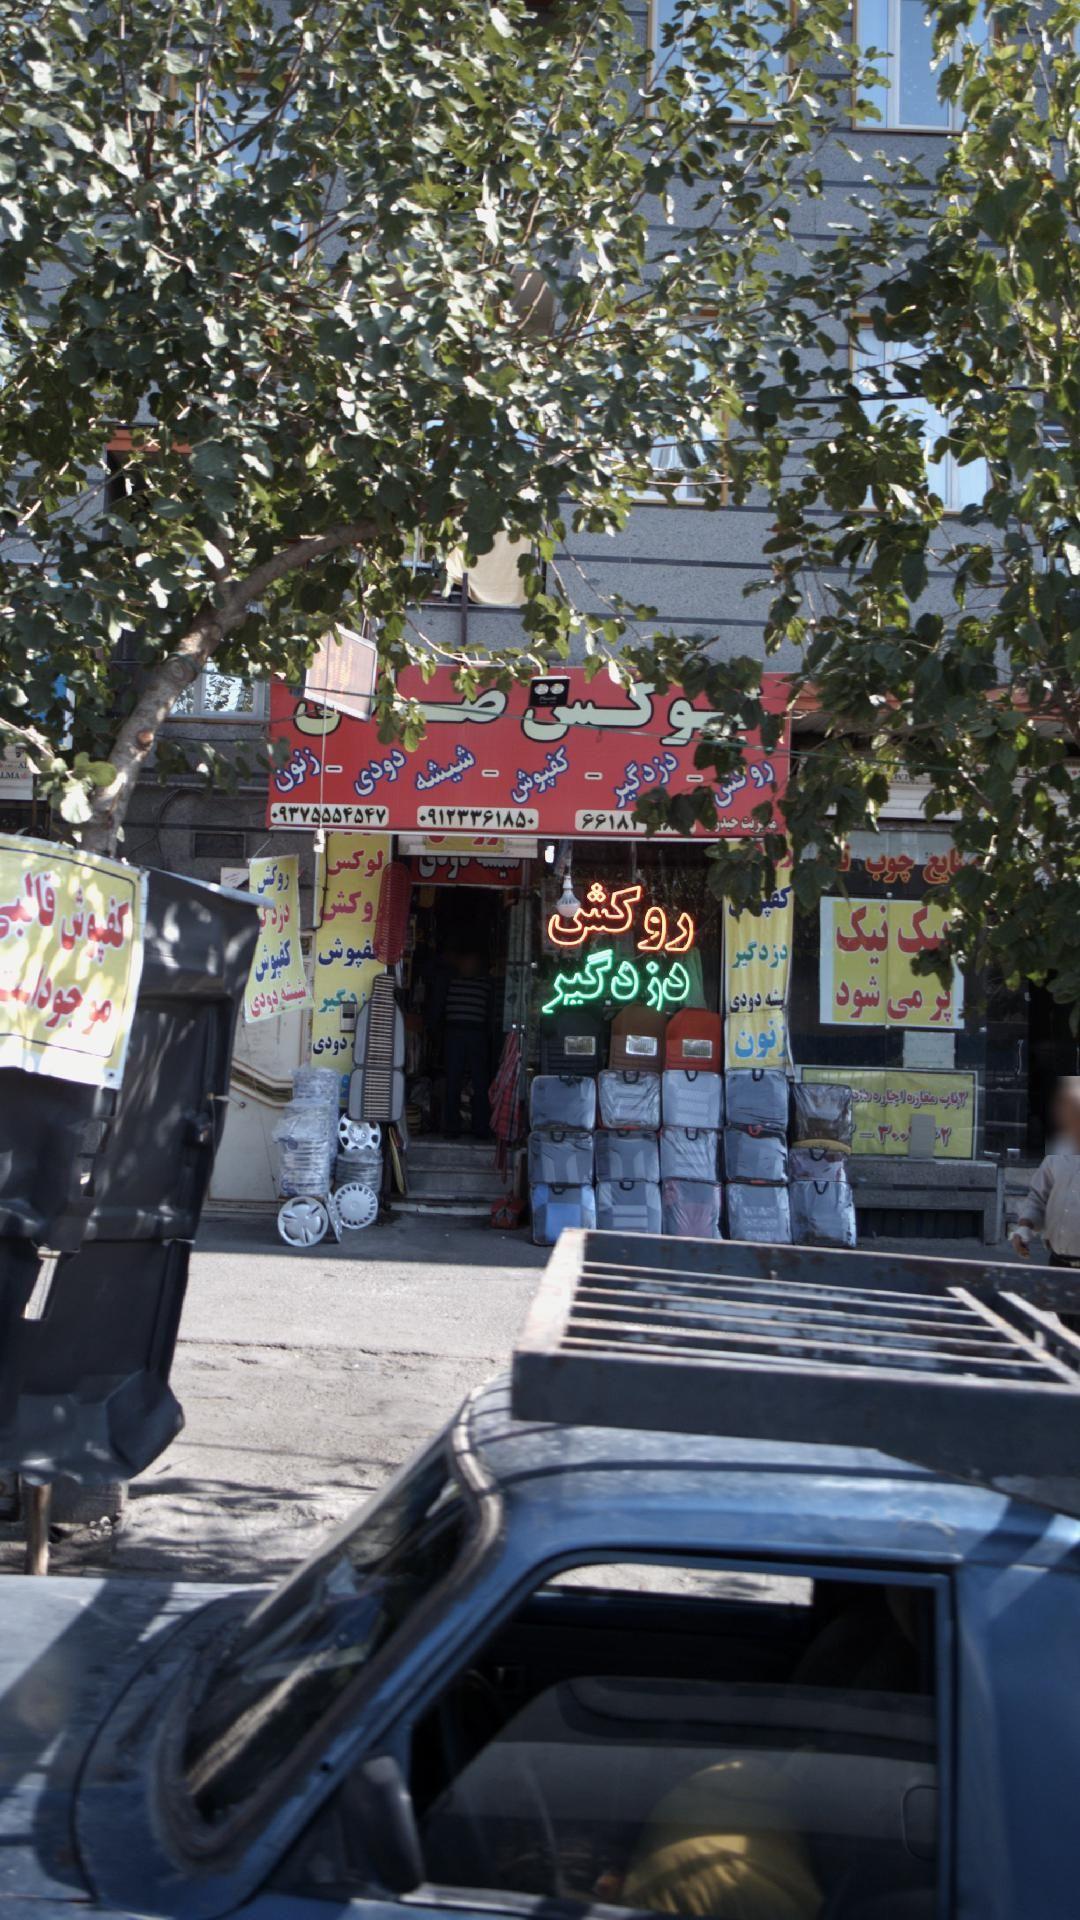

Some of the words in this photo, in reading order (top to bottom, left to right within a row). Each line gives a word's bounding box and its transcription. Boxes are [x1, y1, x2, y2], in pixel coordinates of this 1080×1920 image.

[521, 680, 764, 746] وکس
[274, 747, 322, 793] زنون
[354, 749, 407, 797] دودی
[415, 744, 476, 792] شیشه
[511, 745, 569, 804] کفپوش
[614, 751, 679, 809] دزدگیر
[271, 805, 387, 825] ۰۹۳۷۵۵۵۴۵۴۷
[419, 807, 535, 829] ۰۹۱۲۳۳۶۱۸۵۰
[256, 863, 290, 894] روکش
[327, 849, 385, 877] لوکس
[865, 852, 916, 884] چوب
[320, 891, 374, 923] وکش
[547, 881, 696, 952] روکش
[60, 886, 131, 963] کفپوش
[836, 904, 889, 965] نیک
[255, 938, 291, 983] کفپوش
[318, 938, 378, 967] فپوش
[731, 940, 788, 969] دزدگیر
[541, 948, 691, 1014] دزدگیر
[835, 975, 881, 1019] شود
[251, 989, 279, 1018] دودی
[730, 992, 762, 1014] دودی
[887, 989, 923, 1020] می
[929, 991, 952, 1023] پر
[312, 1036, 348, 1056] دودی
